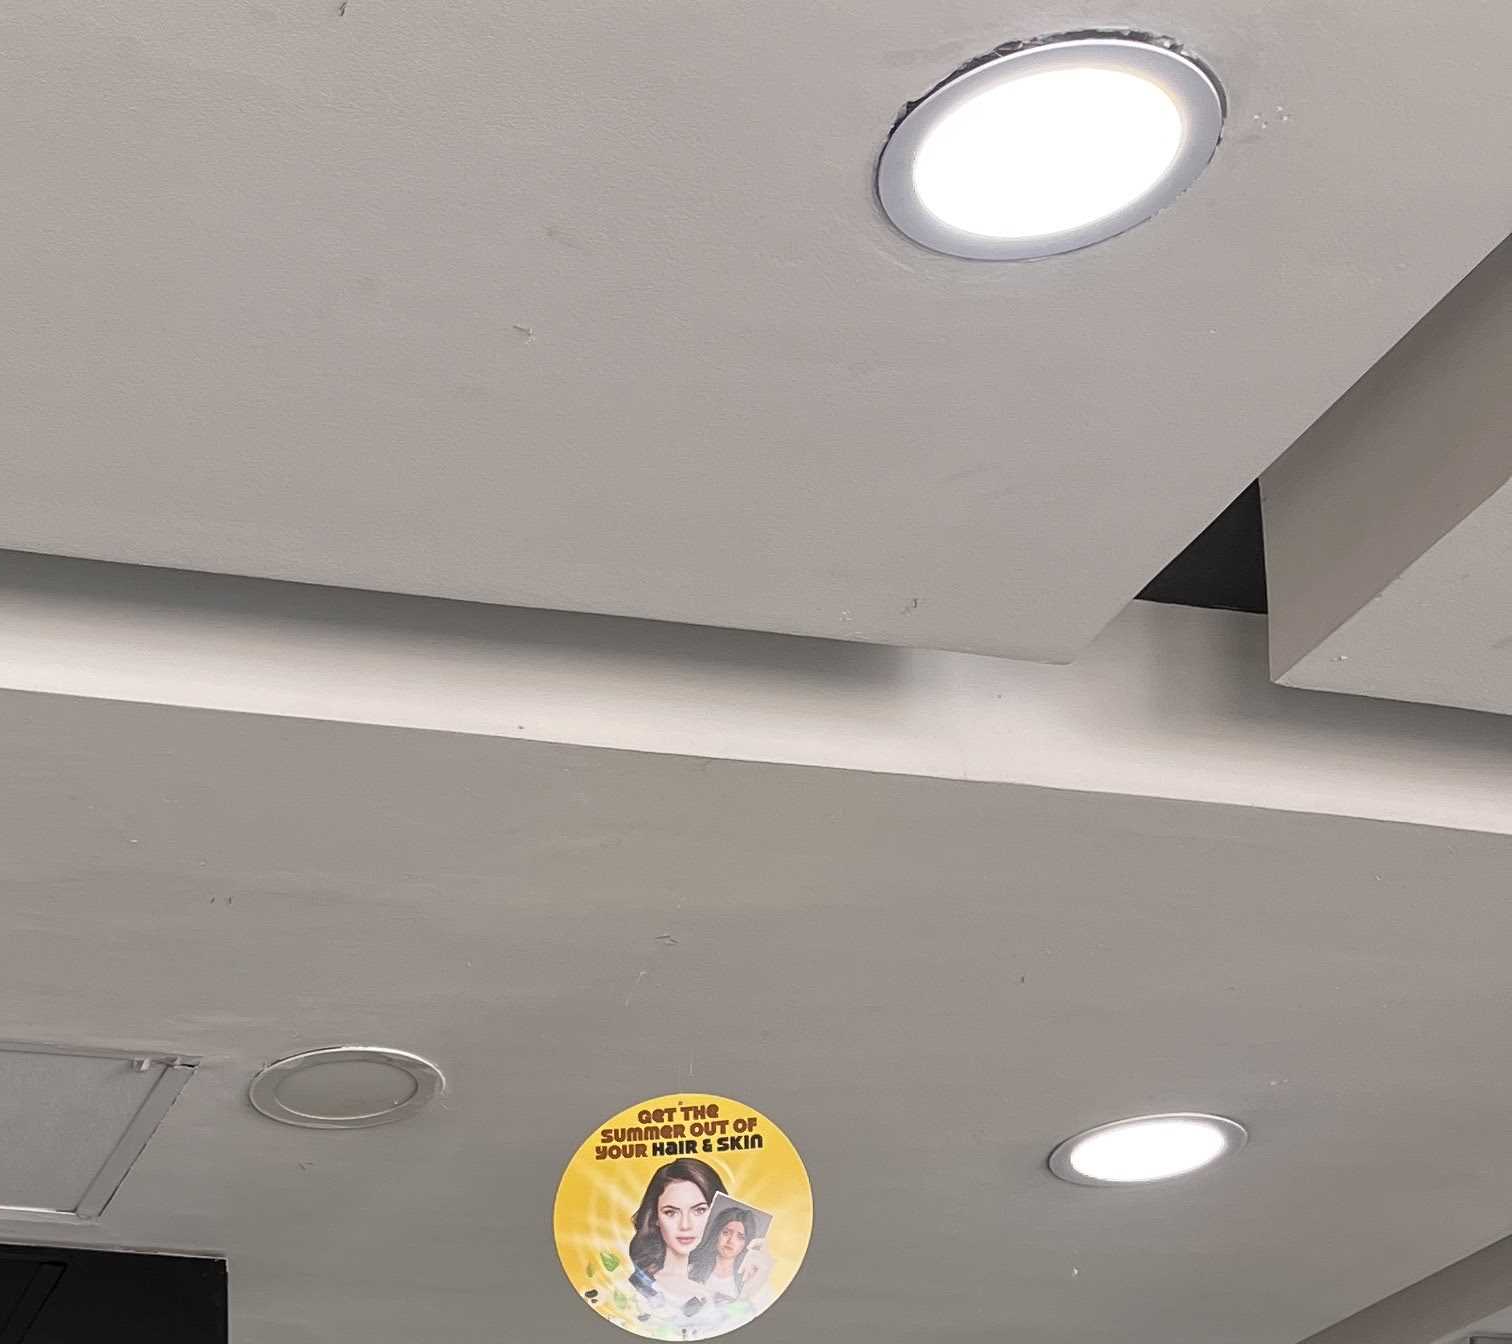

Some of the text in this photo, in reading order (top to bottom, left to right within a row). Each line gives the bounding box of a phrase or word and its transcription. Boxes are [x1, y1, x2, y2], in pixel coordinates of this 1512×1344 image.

[690, 1119, 729, 1137] OUT
[733, 1117, 758, 1133] OF
[595, 1143, 648, 1160] YOUR
[702, 1138, 713, 1152] &
